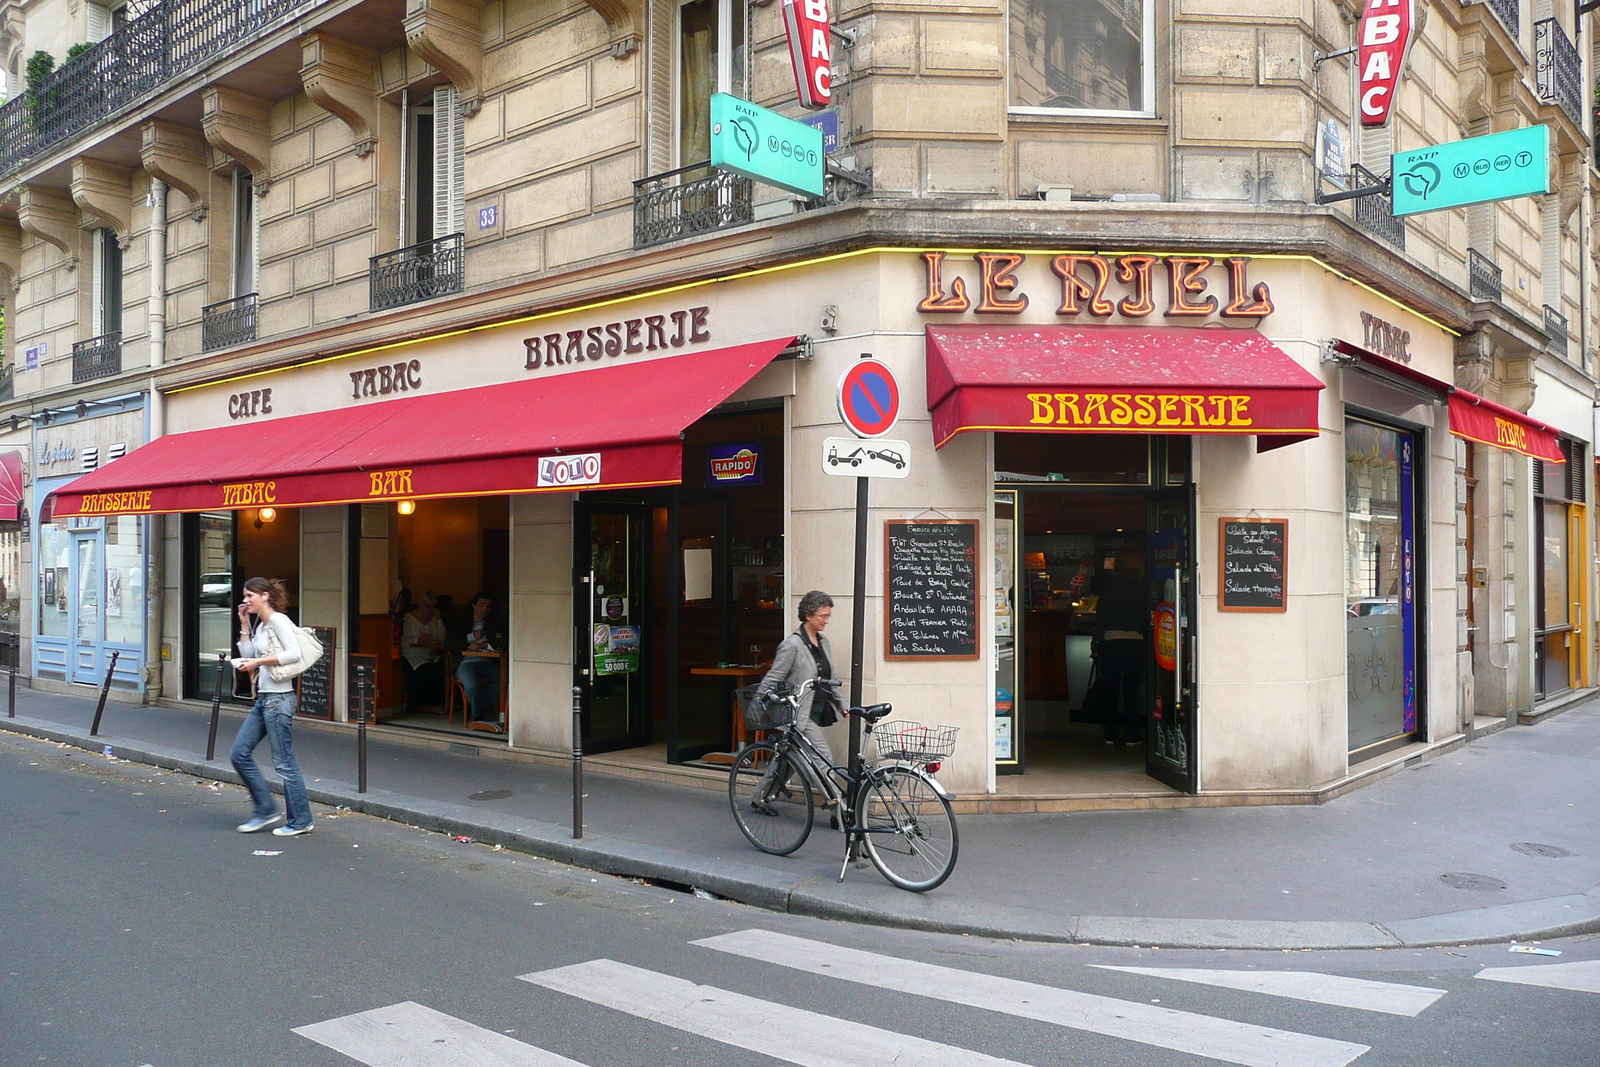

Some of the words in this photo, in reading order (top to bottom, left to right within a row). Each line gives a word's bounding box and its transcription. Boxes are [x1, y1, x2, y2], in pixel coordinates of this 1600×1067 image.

[735, 104, 759, 117] RATP
[1407, 151, 1439, 163] RATP
[481, 208, 495, 227] 33
[917, 251, 1029, 314] LE
[1360, 311, 1412, 364] TABAC
[349, 359, 422, 399] TABAC
[228, 387, 273, 420] CAFE
[1495, 417, 1527, 450] TABAC
[540, 456, 599, 484] LOTO
[715, 460, 752, 472] RAPIDO
[369, 469, 414, 496] BAR
[223, 481, 276, 506] TABAC
[1226, 544, 1254, 556] Salade
[1225, 561, 1252, 574] Salade
[1225, 578, 1252, 593] Salade
[893, 603, 935, 614] Andouillette
[890, 617, 917, 627] Poulet
[894, 630, 909, 641] Nos
[893, 643, 908, 653] Nos
[911, 642, 946, 653] Salades
[605, 663, 613, 671] 50
[612, 662, 625, 671] 000
